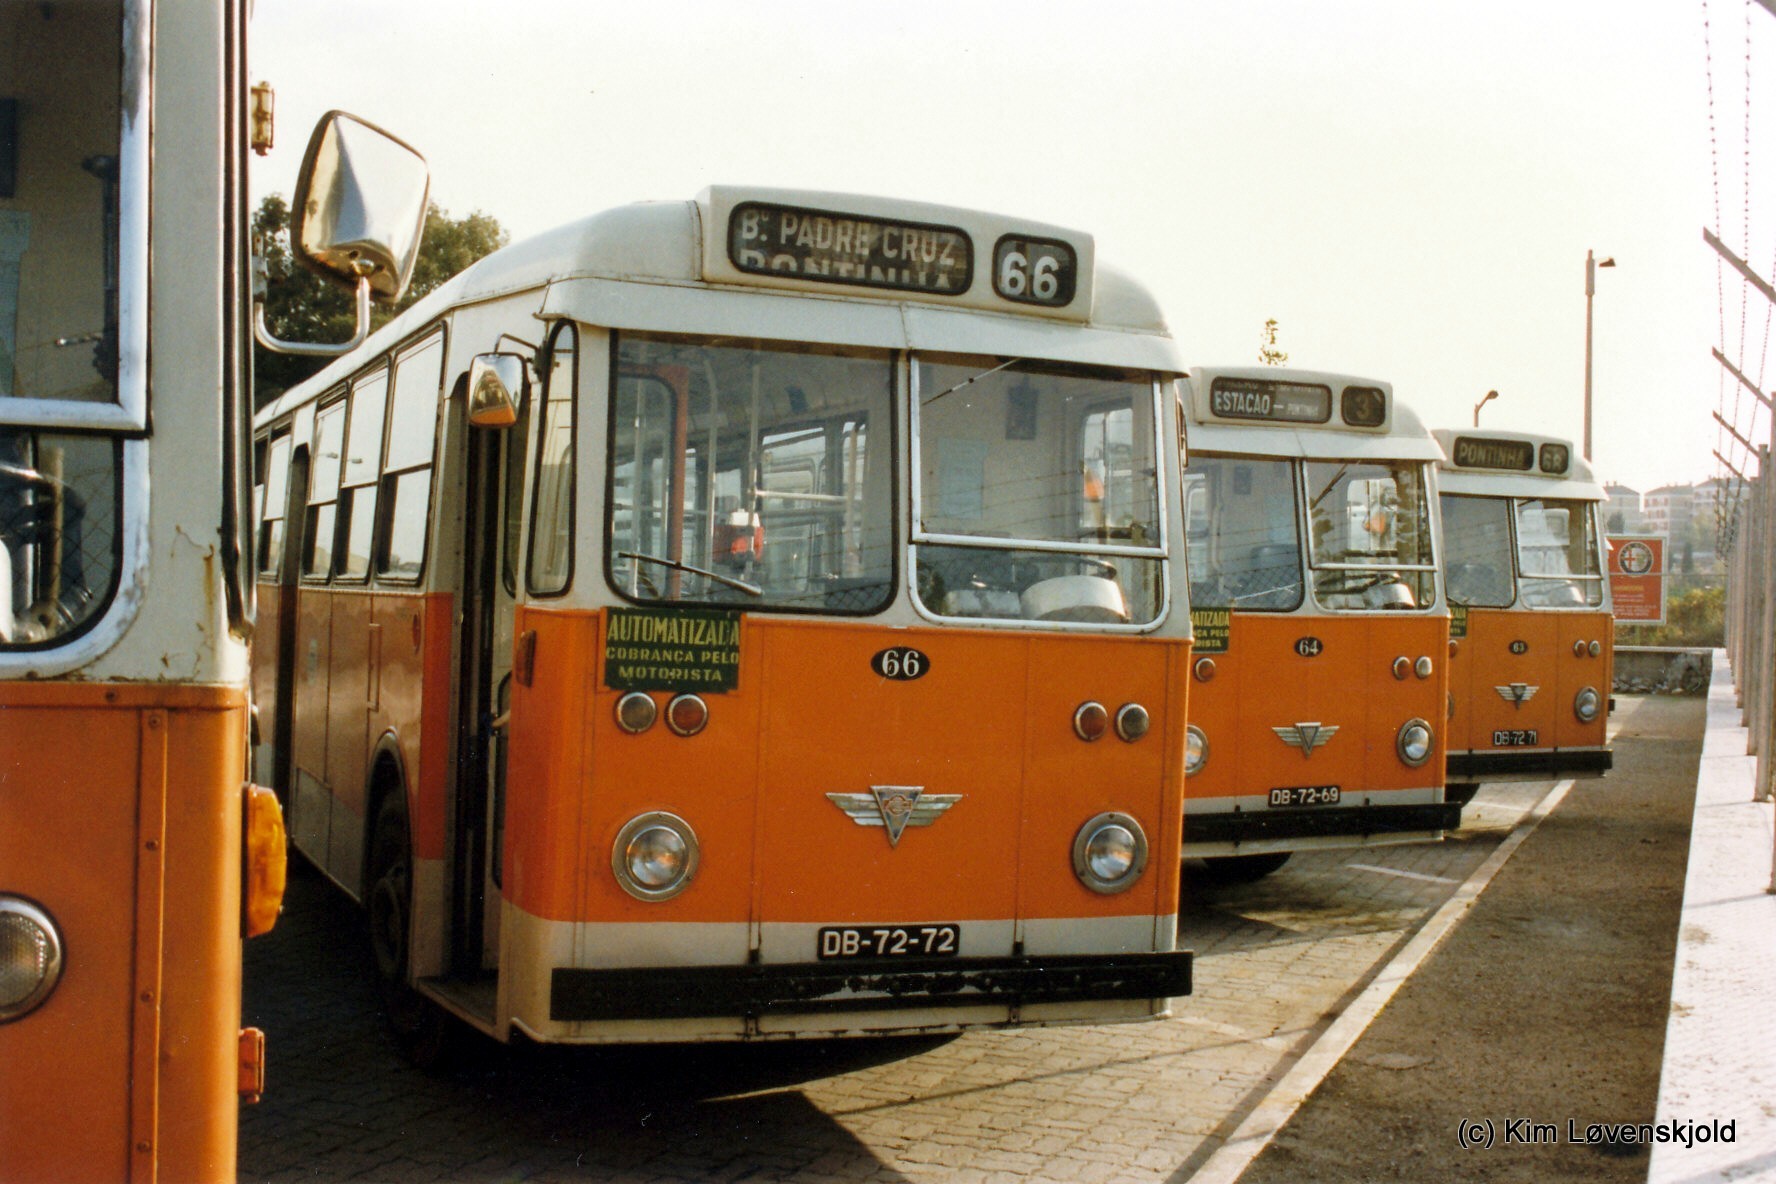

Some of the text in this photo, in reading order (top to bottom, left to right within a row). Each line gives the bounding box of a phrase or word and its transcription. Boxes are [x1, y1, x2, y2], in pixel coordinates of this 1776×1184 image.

[779, 213, 870, 255] PADRE
[882, 226, 955, 267] CRUZ
[1001, 251, 1059, 299] 66
[1459, 442, 1525, 466] PONTINHA
[607, 614, 740, 647] AUTOMATIZADA
[701, 651, 740, 666] PELO
[1299, 640, 1319, 656] 64
[618, 666, 722, 682] MOTORISTA
[881, 649, 920, 677] 66
[1271, 786, 1339, 805] DB-72-69
[823, 927, 956, 956] DB-72-72
